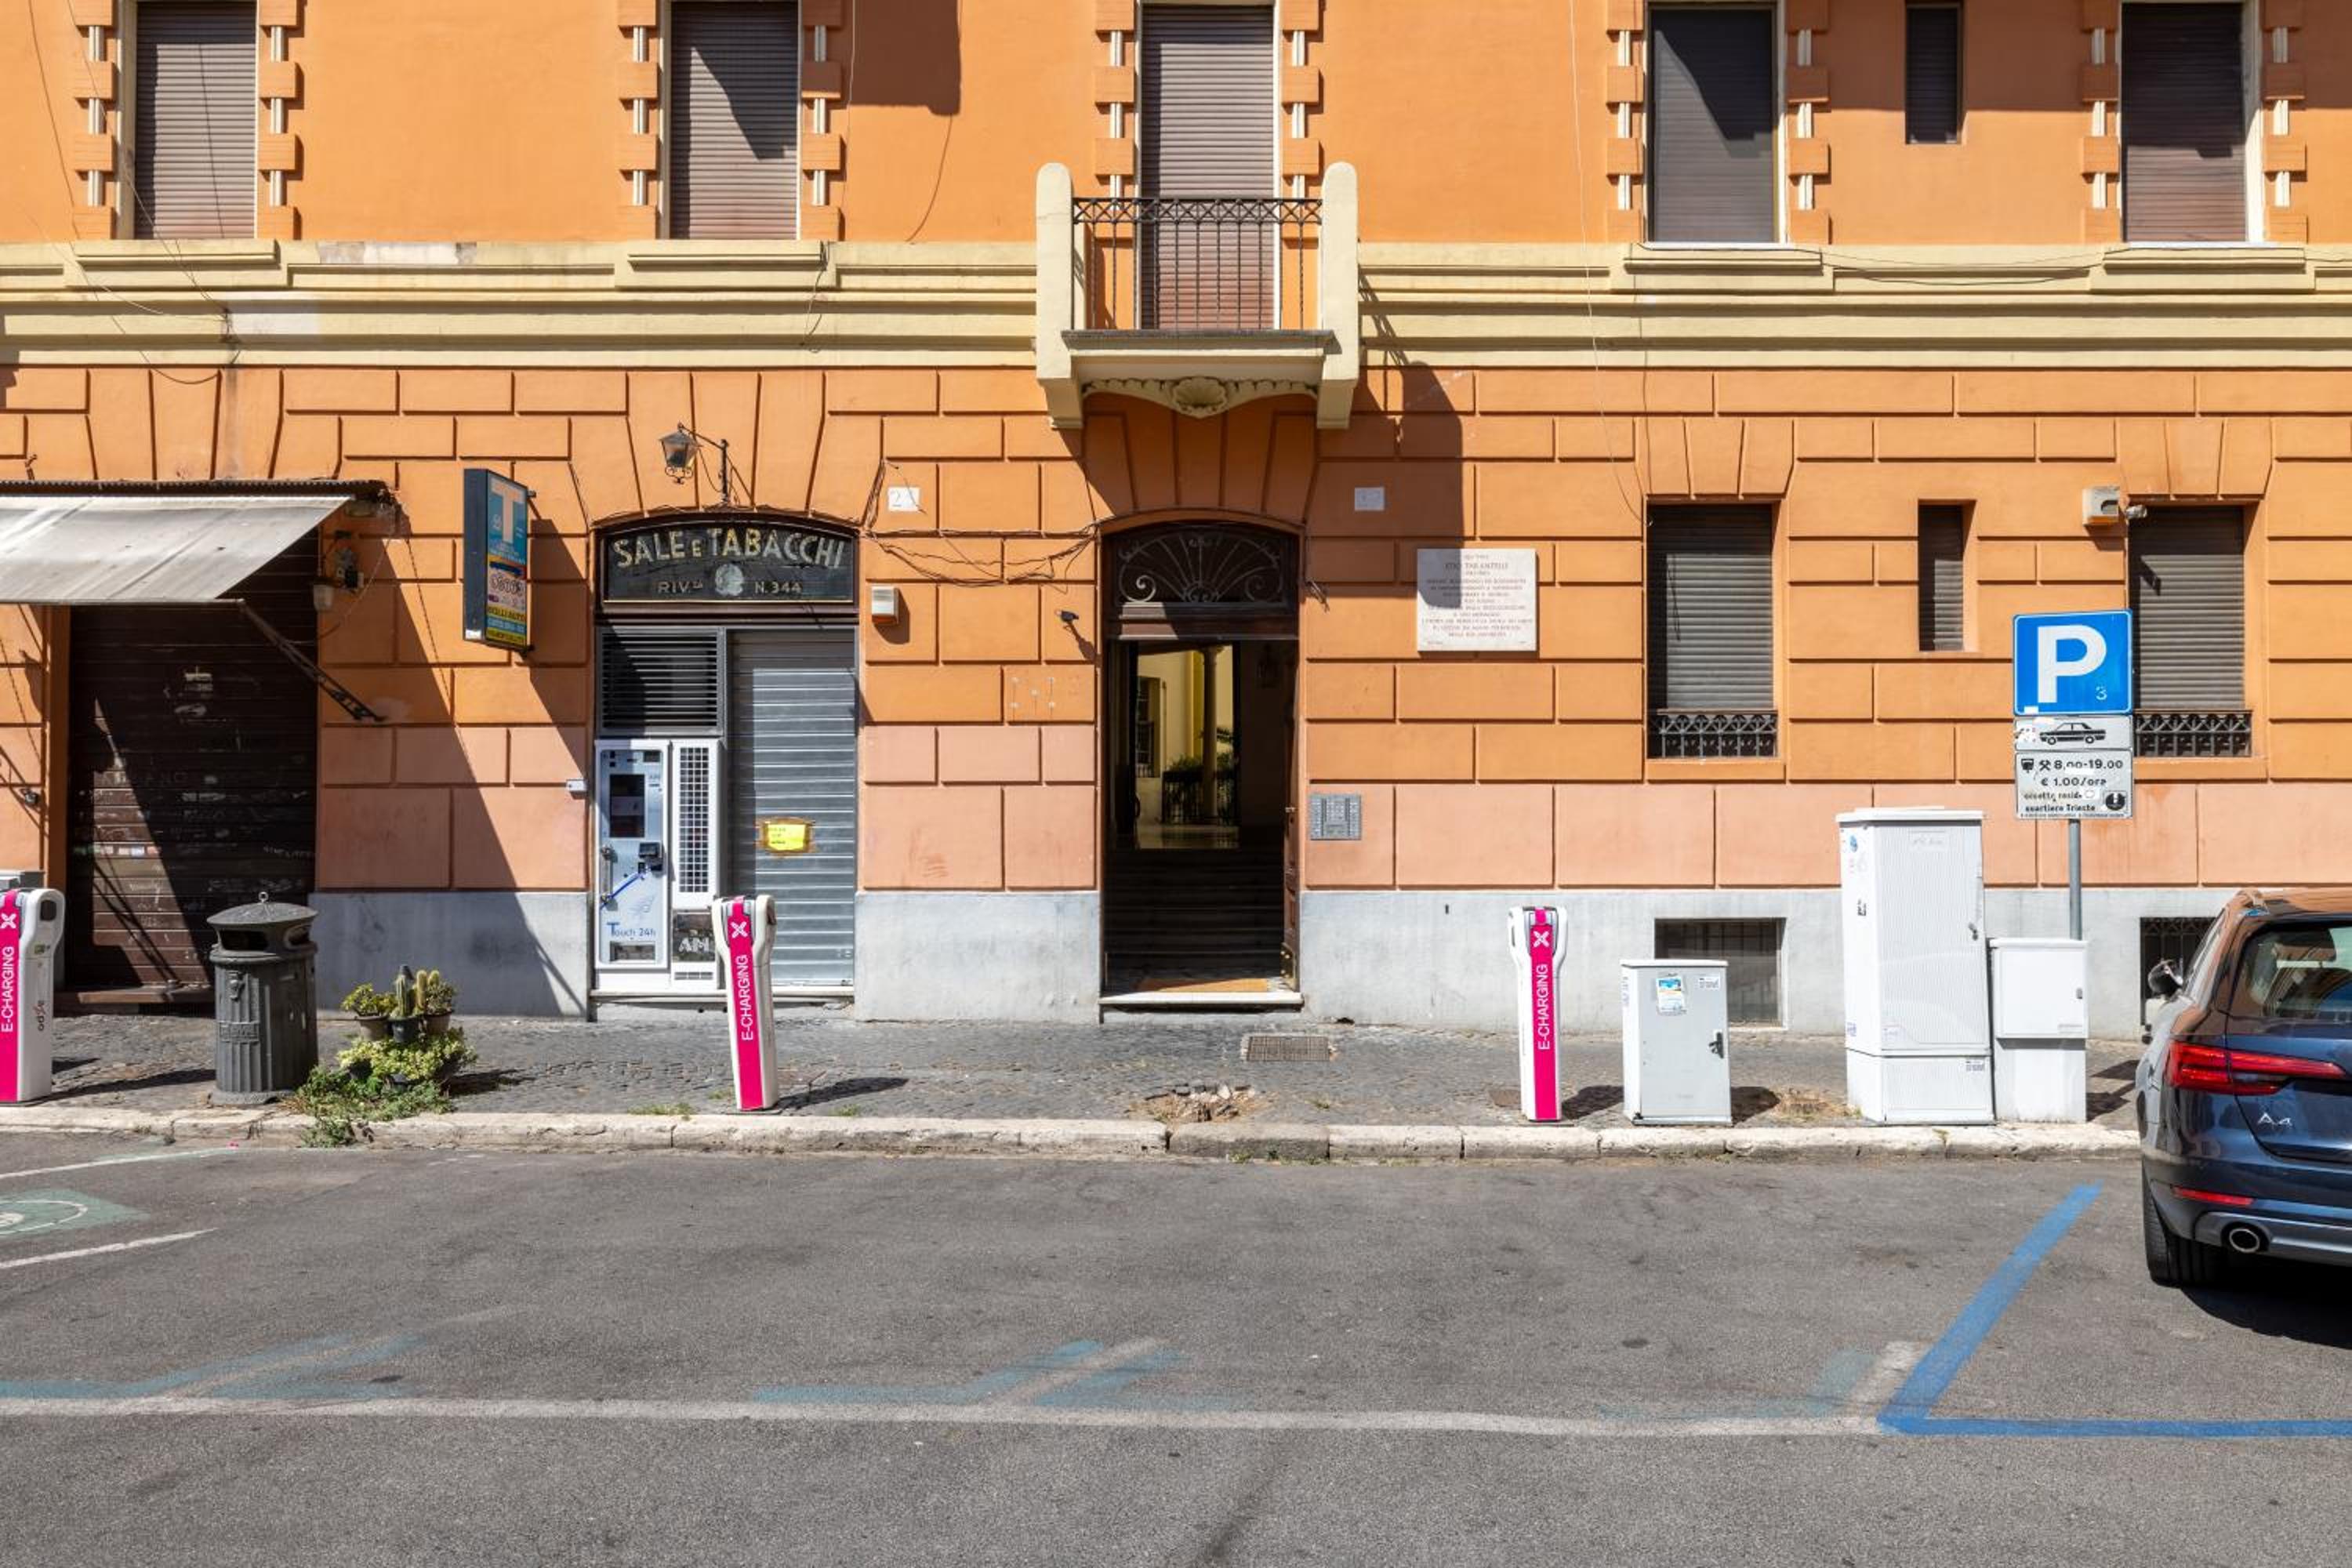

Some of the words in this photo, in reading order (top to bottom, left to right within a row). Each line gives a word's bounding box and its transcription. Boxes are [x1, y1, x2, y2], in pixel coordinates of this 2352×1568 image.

[613, 530, 685, 568] SALE
[692, 539, 702, 557] E
[706, 528, 845, 568] TABACCHI
[2038, 624, 2107, 703] P
[606, 921, 636, 937] Touch
[639, 927, 656, 937] 24h
[1, 946, 15, 1032] E-CHARGING
[735, 954, 753, 1040] E-CHARGING
[1536, 964, 1550, 1050] E-CHARGING
